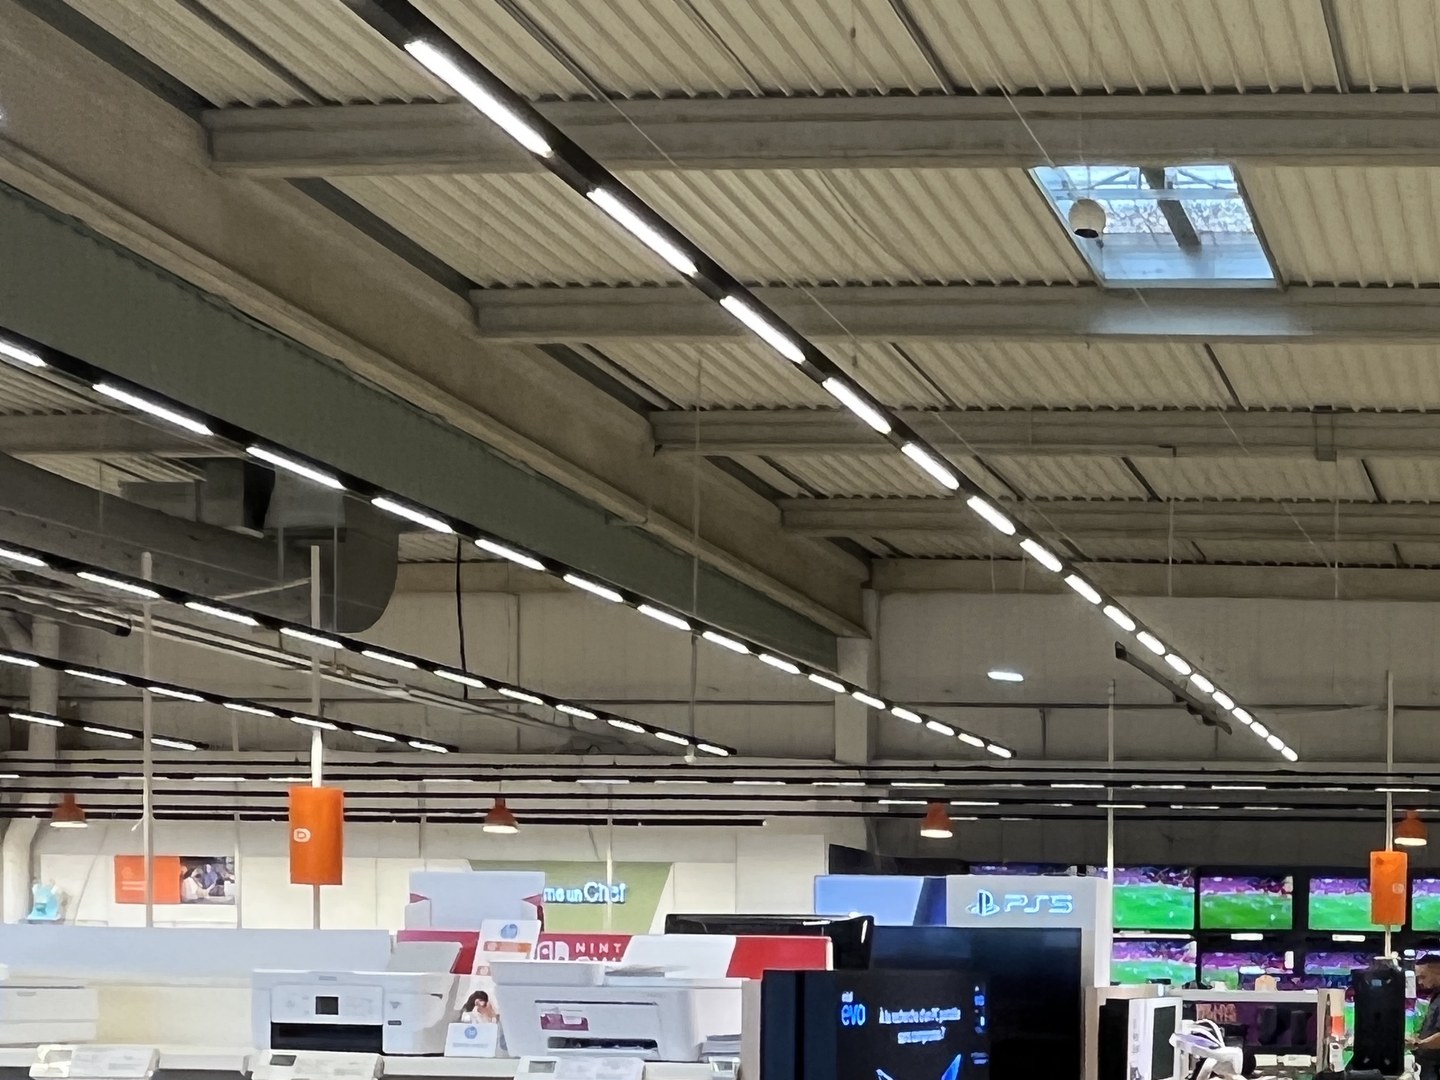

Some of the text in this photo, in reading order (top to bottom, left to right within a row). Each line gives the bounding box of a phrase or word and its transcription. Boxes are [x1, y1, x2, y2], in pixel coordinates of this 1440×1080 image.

[1004, 894, 1073, 913] PS5
[575, 942, 622, 954] NINT
[841, 1003, 866, 1026] evo
